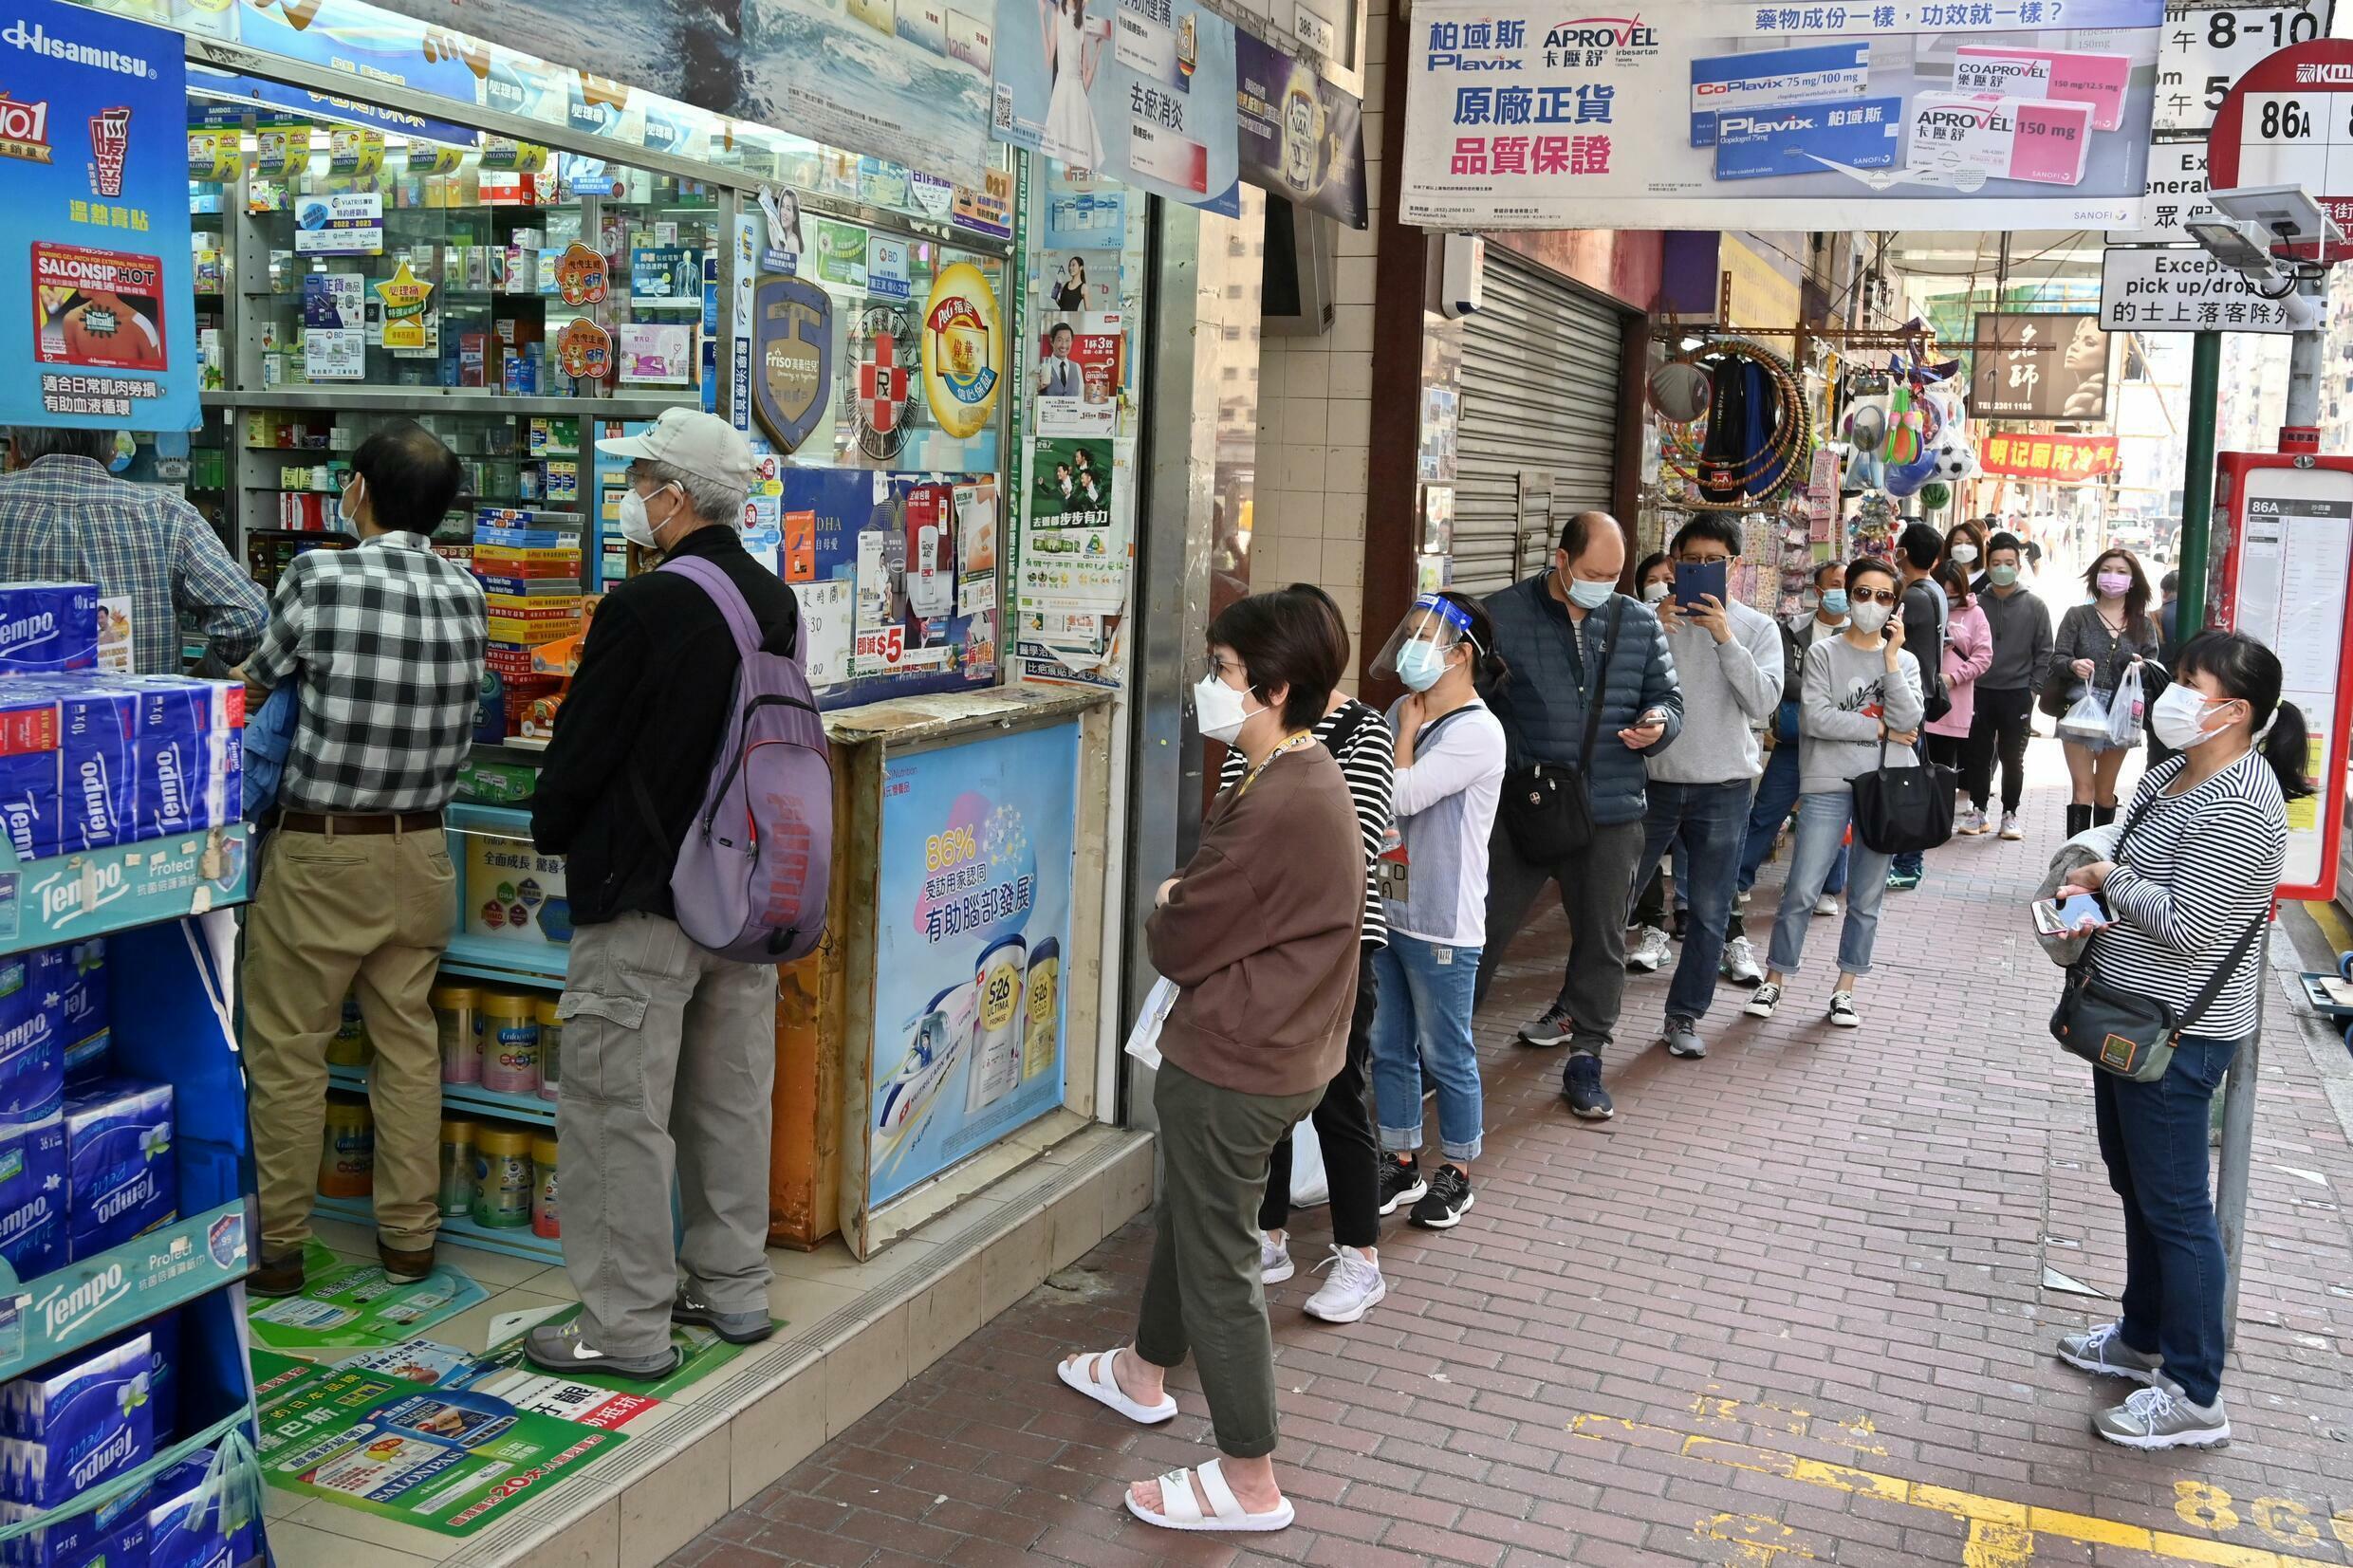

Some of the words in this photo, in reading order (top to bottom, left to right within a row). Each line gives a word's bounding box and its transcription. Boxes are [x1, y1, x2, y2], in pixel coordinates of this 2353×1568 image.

[1299, 16, 1312, 38] 386
[1429, 20, 1526, 51] 柏域斯
[1543, 19, 1658, 48] APROVEL
[2208, 11, 2317, 48] 8-10
[2, 20, 146, 78] Hisamitsu
[1543, 49, 1603, 68] 卡壓舒
[1427, 54, 1524, 72] Plavix
[489, 80, 523, 102] 必理痛
[1697, 79, 1783, 96] CoPlavix
[1787, 76, 1800, 87] 75
[1802, 73, 1841, 87] mg/100
[1843, 73, 1859, 83] mg
[2105, 84, 2119, 93] mg
[571, 103, 603, 123] 必理痛
[1453, 83, 1616, 125] 原廠正貨
[1291, 115, 1310, 139] NAN
[1720, 116, 1814, 137] Plavix
[1918, 108, 2013, 132] APROVEL
[2018, 121, 2046, 135] 150
[2051, 125, 2076, 139] mg
[2261, 101, 2311, 138] 86A
[1720, 135, 1751, 144] Clopidogrel
[1751, 134, 1768, 142] 75mg
[1450, 135, 1611, 175] 品質保證
[1853, 157, 1881, 165] SANOFI
[2032, 170, 2060, 179] SANOFI
[2145, 175, 2210, 194] eneral
[986, 175, 1007, 198] 021
[333, 220, 349, 229] 2022
[355, 219, 372, 228] 2023
[2074, 212, 2113, 220] SANOFI
[39, 257, 117, 282] SALONSIP
[118, 269, 155, 286] HOT
[2126, 278, 2169, 295] pick
[2177, 278, 2255, 296] up/drop
[937, 300, 953, 328] P&G
[767, 351, 791, 368] Friso
[45, 397, 130, 415] 有助血液循環
[2252, 501, 2279, 513] 86A
[817, 517, 842, 531] DHA
[0, 612, 53, 645] empo
[804, 618, 823, 632] :30
[806, 663, 824, 676] :00
[156, 750, 181, 836] Tempo
[883, 782, 911, 798] 氏營養品
[81, 759, 112, 850] Tempo
[926, 823, 975, 872] 86%
[149, 856, 195, 876] Protect
[484, 851, 530, 870] 全面成長
[535, 857, 566, 874] 驚喜
[925, 863, 987, 901] 受訪用家認同
[925, 875, 1030, 944] 有助腦部發展
[987, 1000, 1010, 1017] ULTIMA
[0, 1012, 46, 1054] empo
[99, 1172, 155, 1224] Tempo
[35, 1263, 123, 1337] Tempo
[75, 1426, 133, 1490] Tempo
[371, 1450, 464, 1502] SALONPAS
